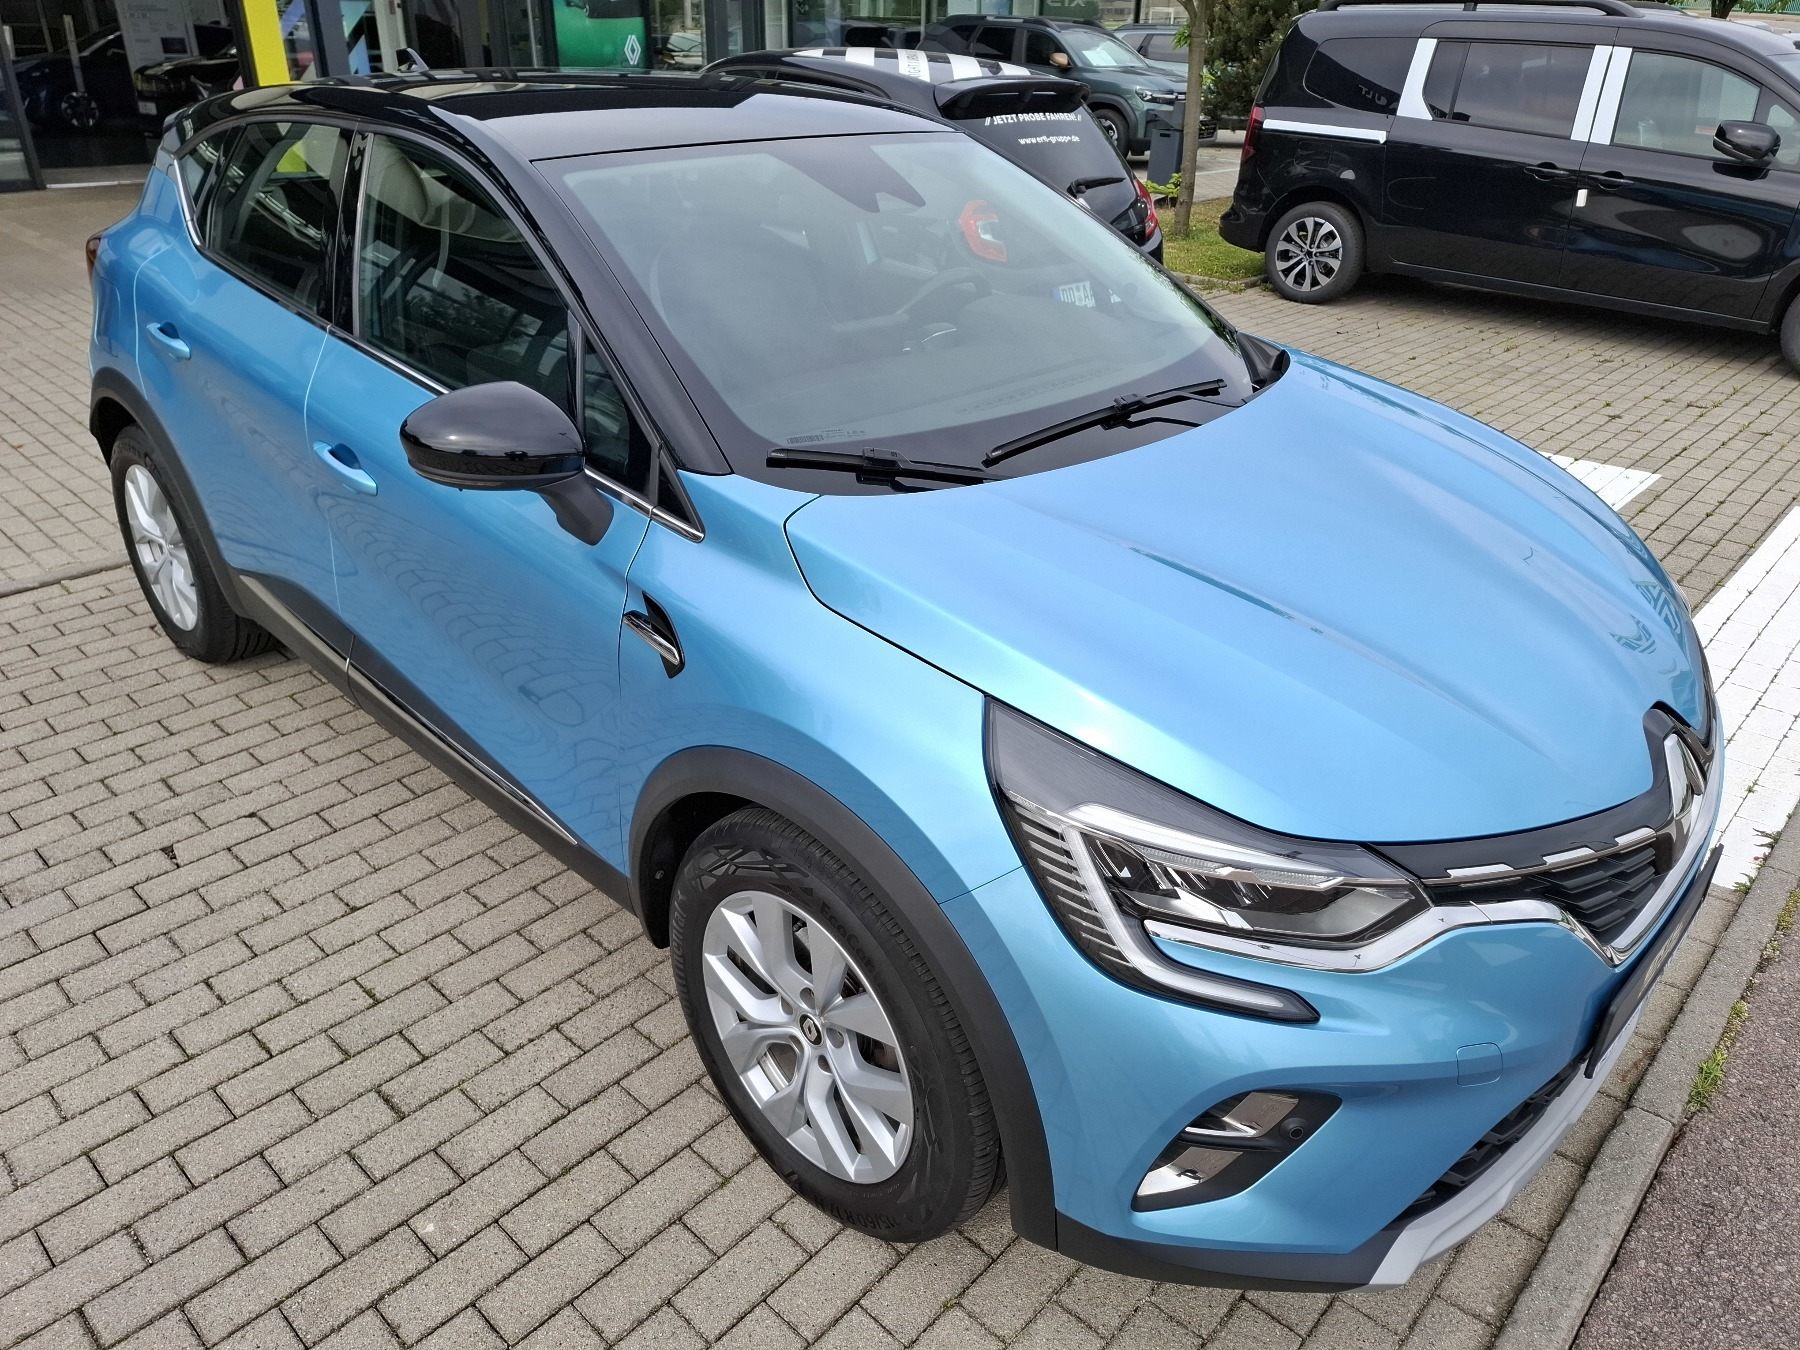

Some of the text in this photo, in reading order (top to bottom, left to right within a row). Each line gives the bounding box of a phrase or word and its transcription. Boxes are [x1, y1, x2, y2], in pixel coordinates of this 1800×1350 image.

[993, 114, 1017, 125] JETZT
[1017, 113, 1045, 122] PROBE
[1045, 112, 1077, 121] FAHREN!
